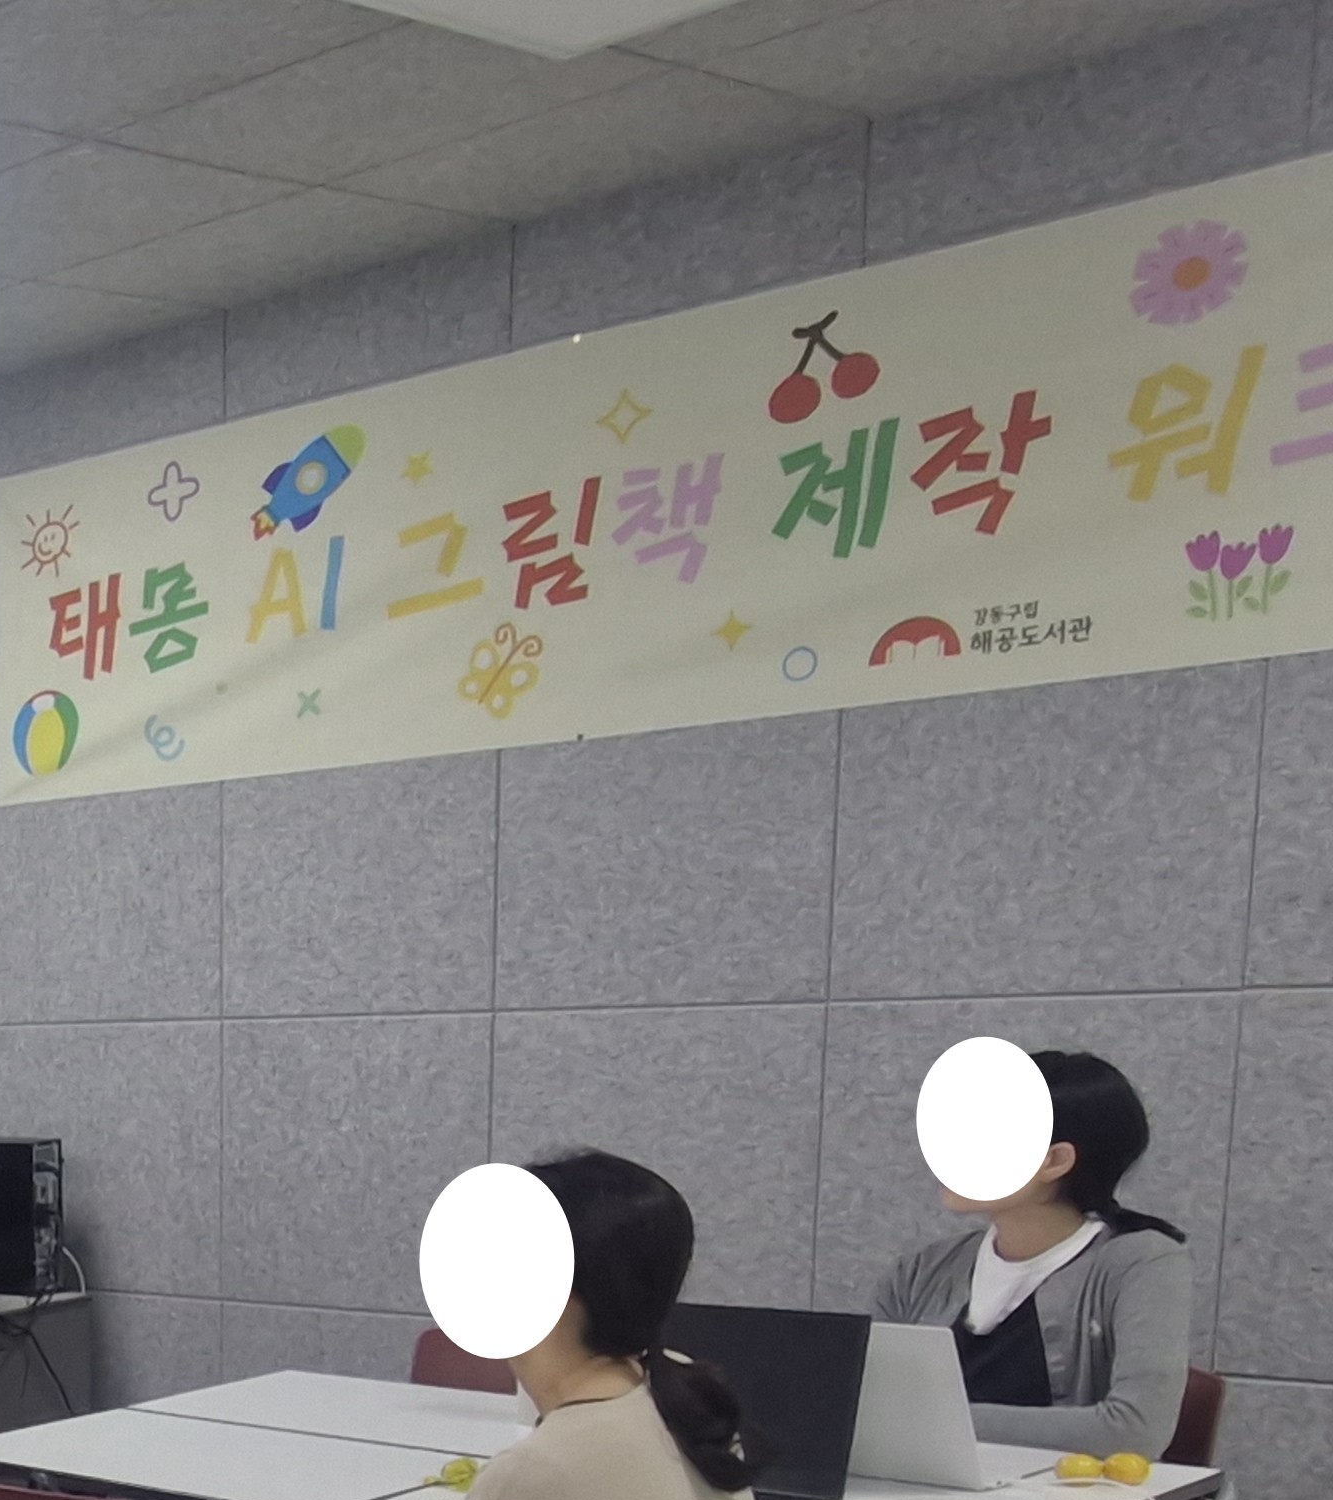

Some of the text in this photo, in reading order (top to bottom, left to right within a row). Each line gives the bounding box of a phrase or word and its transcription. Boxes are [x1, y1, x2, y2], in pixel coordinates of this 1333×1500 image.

[49, 561, 209, 680] 태몽
[245, 534, 346, 644] AI
[386, 452, 725, 620] 그림책
[770, 389, 1052, 559] 제작
[973, 600, 1039, 627] 강동구립
[969, 614, 1093, 655] 해공도서관
